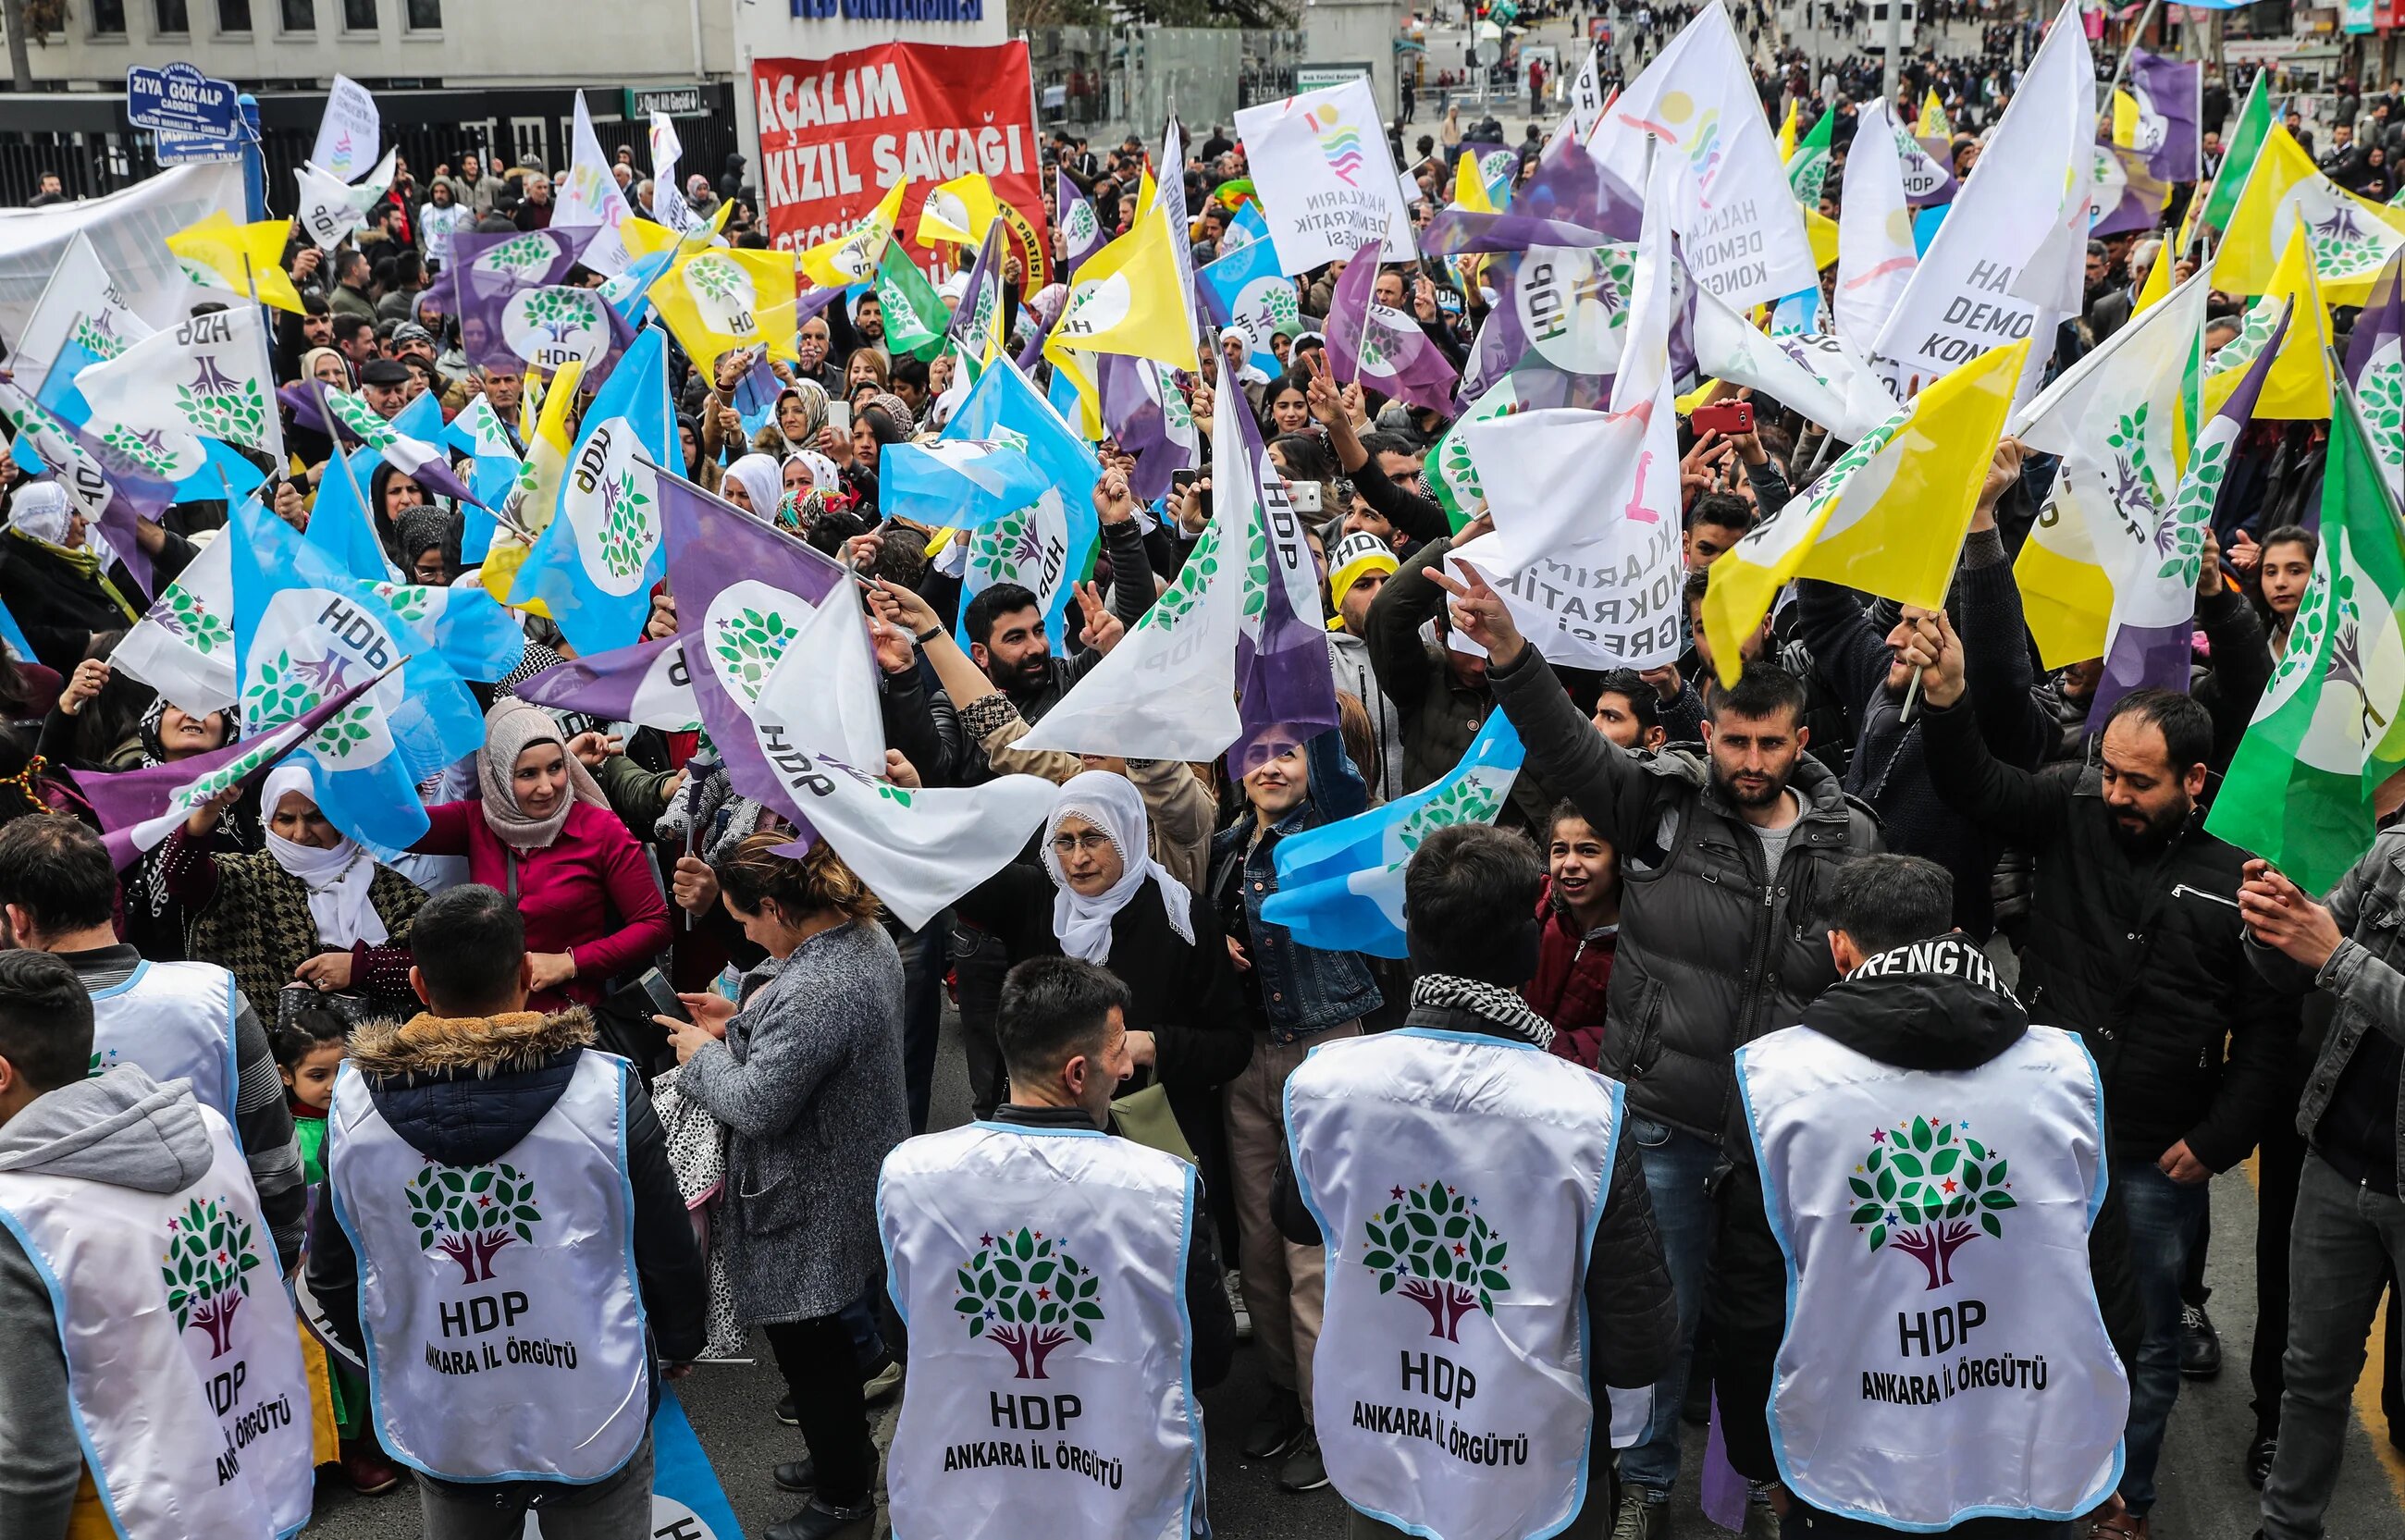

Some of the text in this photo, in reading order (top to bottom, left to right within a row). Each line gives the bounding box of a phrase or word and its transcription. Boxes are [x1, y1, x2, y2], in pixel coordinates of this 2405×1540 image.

[133, 76, 163, 96] ZİYA
[758, 62, 908, 147] AÇALIM
[765, 142, 863, 208] KIZIL
[176, 314, 232, 346] HDP
[728, 311, 755, 334] HD
[575, 427, 611, 495] HDP
[1263, 483, 1299, 570] HDP
[759, 725, 836, 797] HDP
[439, 1291, 529, 1337] HDP
[1898, 1300, 1987, 1357] HDP
[426, 1336, 577, 1375] ANKARA İL ÖRGÜTÜ
[1400, 1350, 1476, 1410] HDP
[1862, 1352, 2047, 1405] ANKARA İL ÖRGÜTÜ
[235, 1393, 291, 1449] ÖRGÜTÜ
[990, 1391, 1082, 1431] HDP
[1353, 1400, 1528, 1466] ANKARA İL ÖRGÜTÜ
[944, 1439, 1123, 1490] ANKARA İL ÖRGÜTÜ
